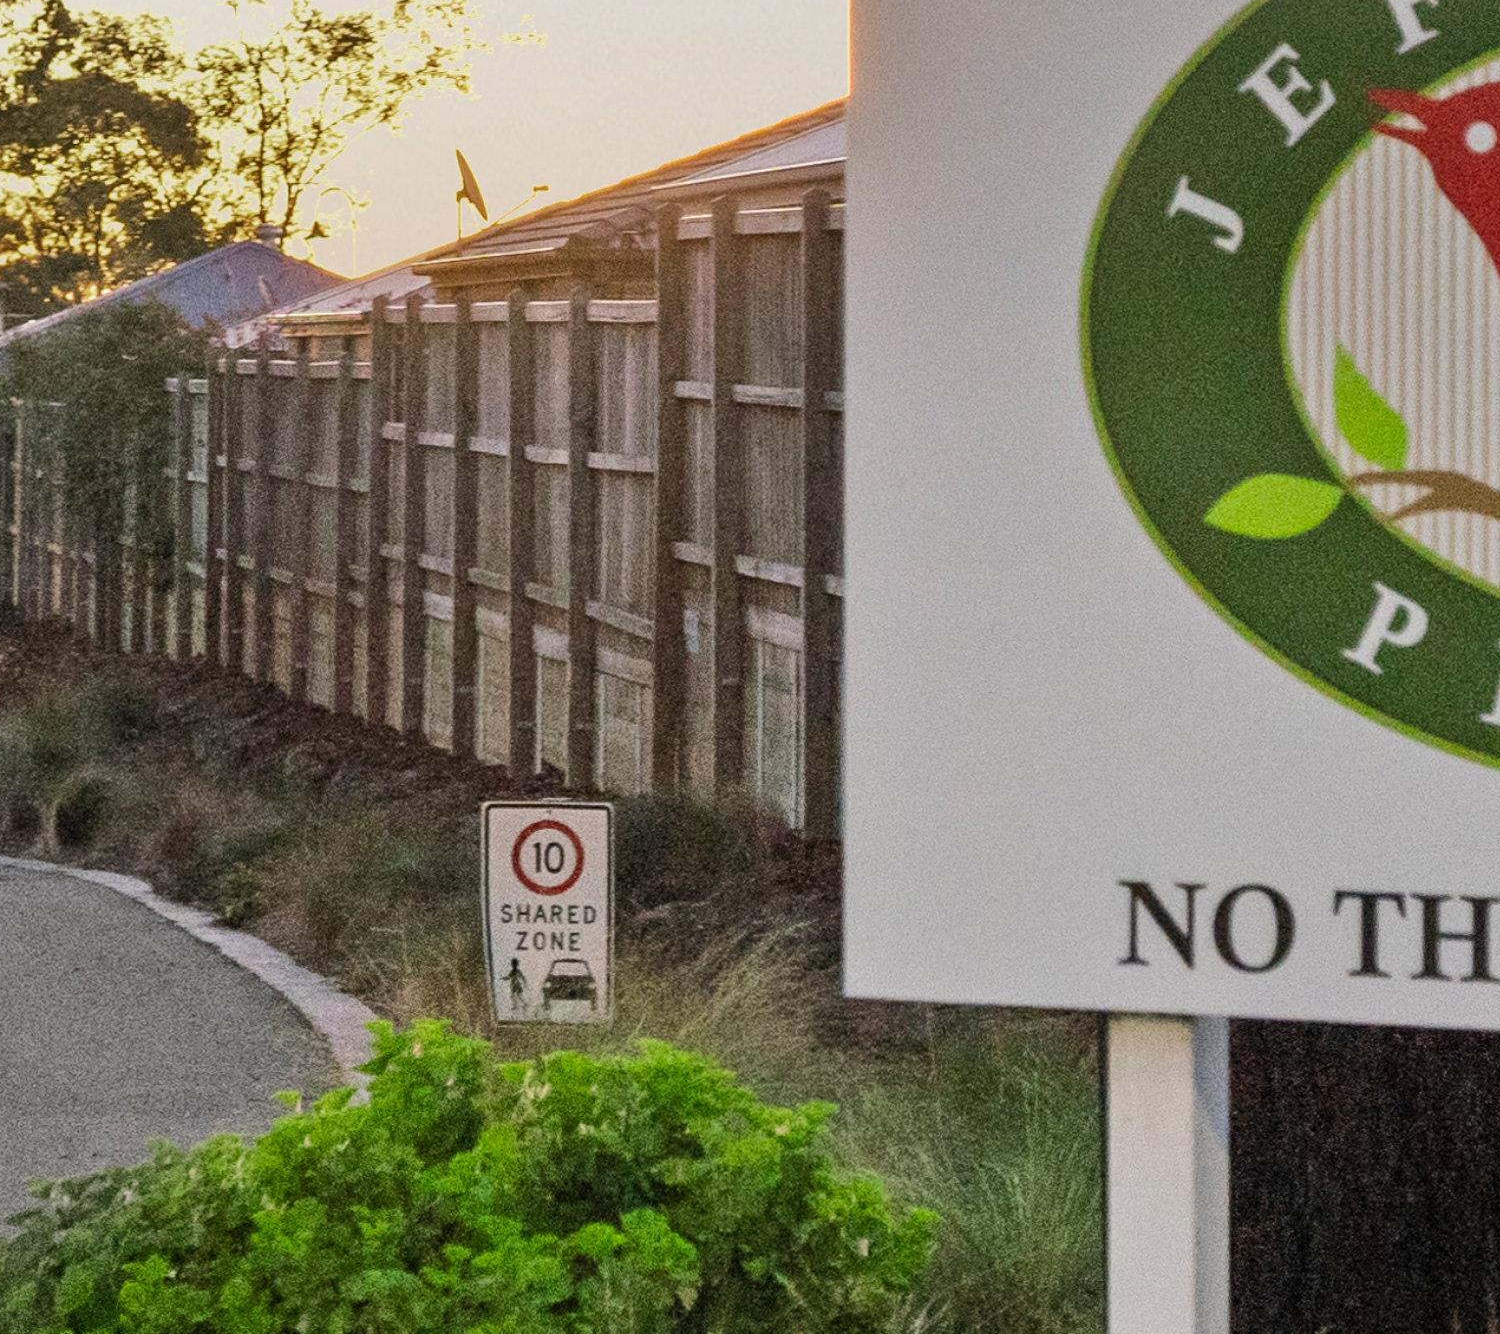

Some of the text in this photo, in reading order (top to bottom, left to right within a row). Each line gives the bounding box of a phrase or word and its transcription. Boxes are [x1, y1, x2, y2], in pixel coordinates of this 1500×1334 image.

[533, 841, 565, 873] 10
[500, 904, 597, 924] SHARED
[1117, 880, 1295, 973] NO
[516, 931, 581, 951] ZONE
